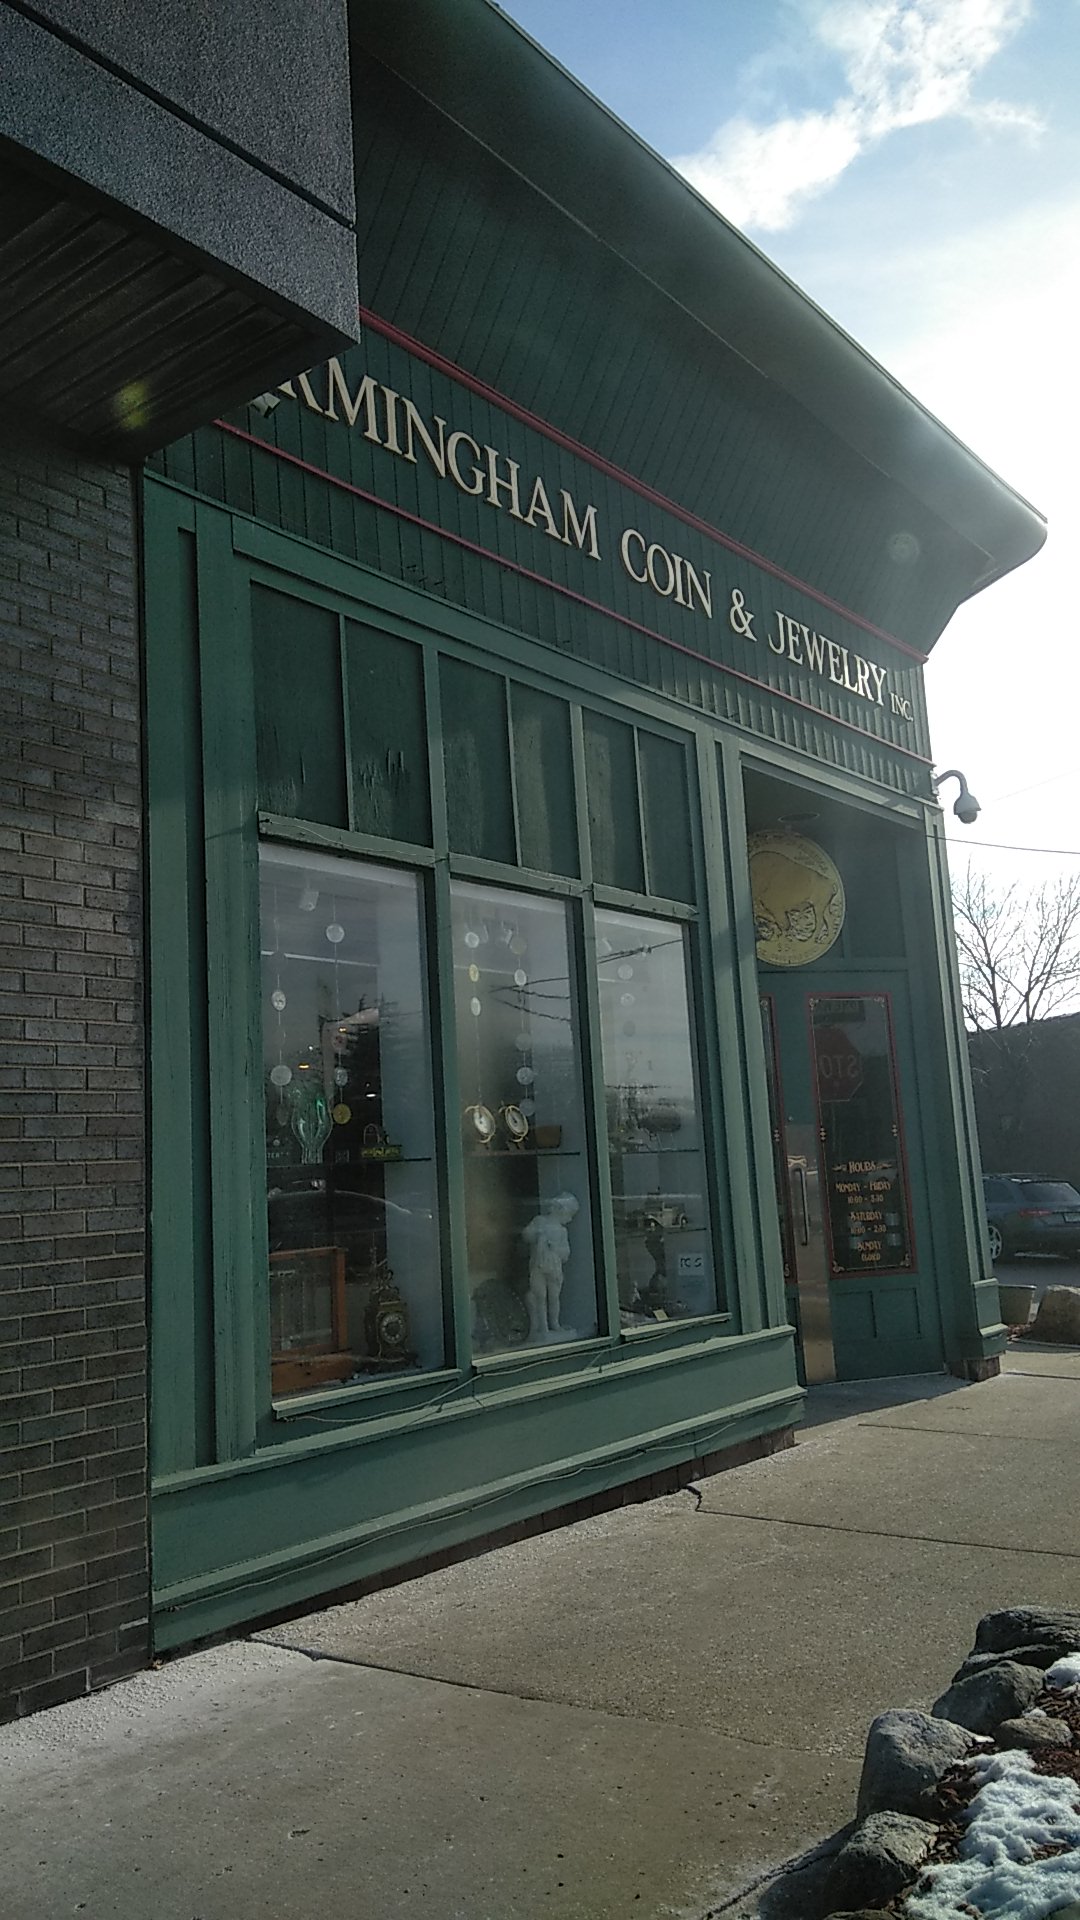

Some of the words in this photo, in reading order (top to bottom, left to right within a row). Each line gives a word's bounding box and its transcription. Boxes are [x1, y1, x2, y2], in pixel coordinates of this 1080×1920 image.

[621, 528, 712, 619] COIN
[730, 588, 757, 642] &
[768, 610, 886, 707] JEWELRY
[890, 692, 914, 722] INC.
[835, 1182, 860, 1193] MONDAY
[869, 1181, 891, 1191] FRIDAY
[850, 1211, 882, 1221] SATURDAY
[857, 1240, 882, 1252] SUNDAY
[861, 1253, 881, 1262] CLOSED
